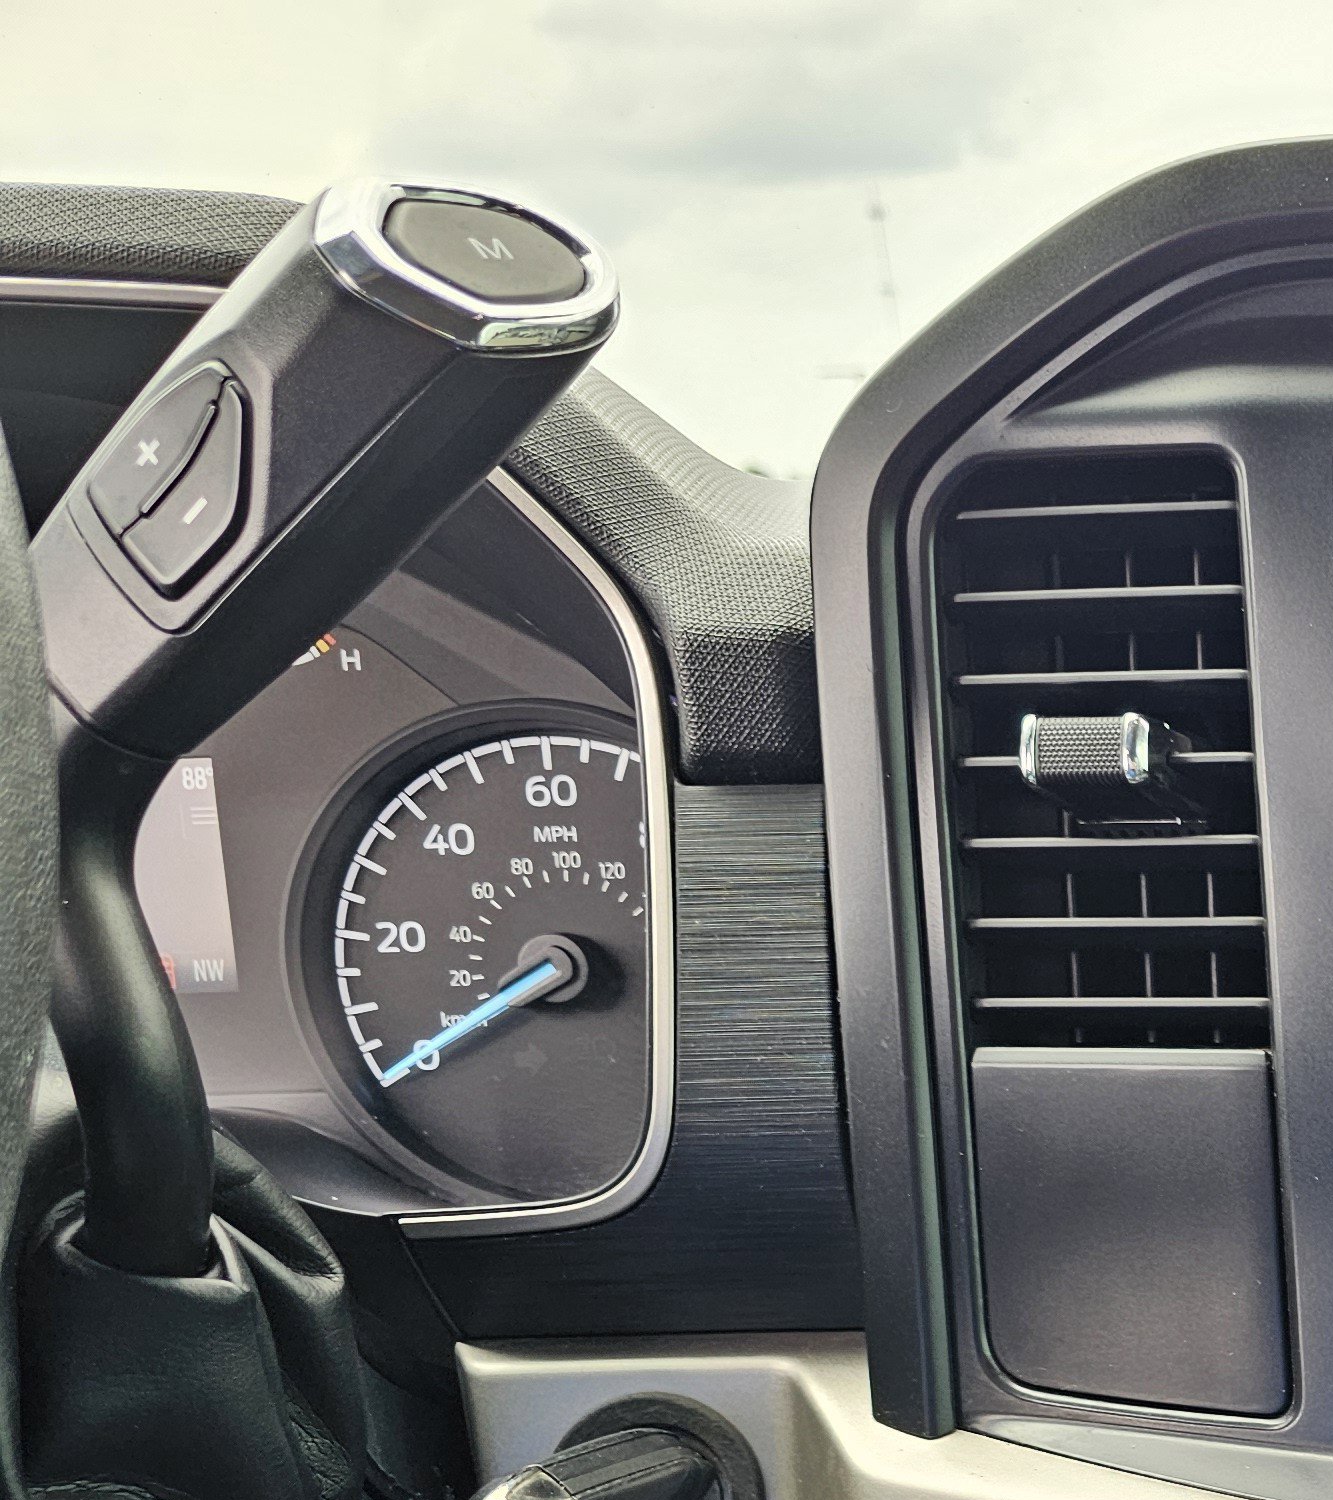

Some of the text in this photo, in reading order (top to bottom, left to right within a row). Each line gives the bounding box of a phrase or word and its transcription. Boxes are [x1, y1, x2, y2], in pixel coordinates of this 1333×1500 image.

[469, 236, 514, 262] M
[340, 648, 362, 672] H
[524, 773, 578, 808] 60
[423, 822, 475, 856] 40
[533, 826, 578, 844] MPH
[509, 858, 534, 876] 80
[551, 850, 581, 869] 100
[598, 861, 626, 880] 120
[471, 881, 495, 901] 60
[375, 921, 426, 953] 20
[448, 925, 472, 944] 40
[193, 958, 225, 982] NW
[448, 969, 472, 987] 20
